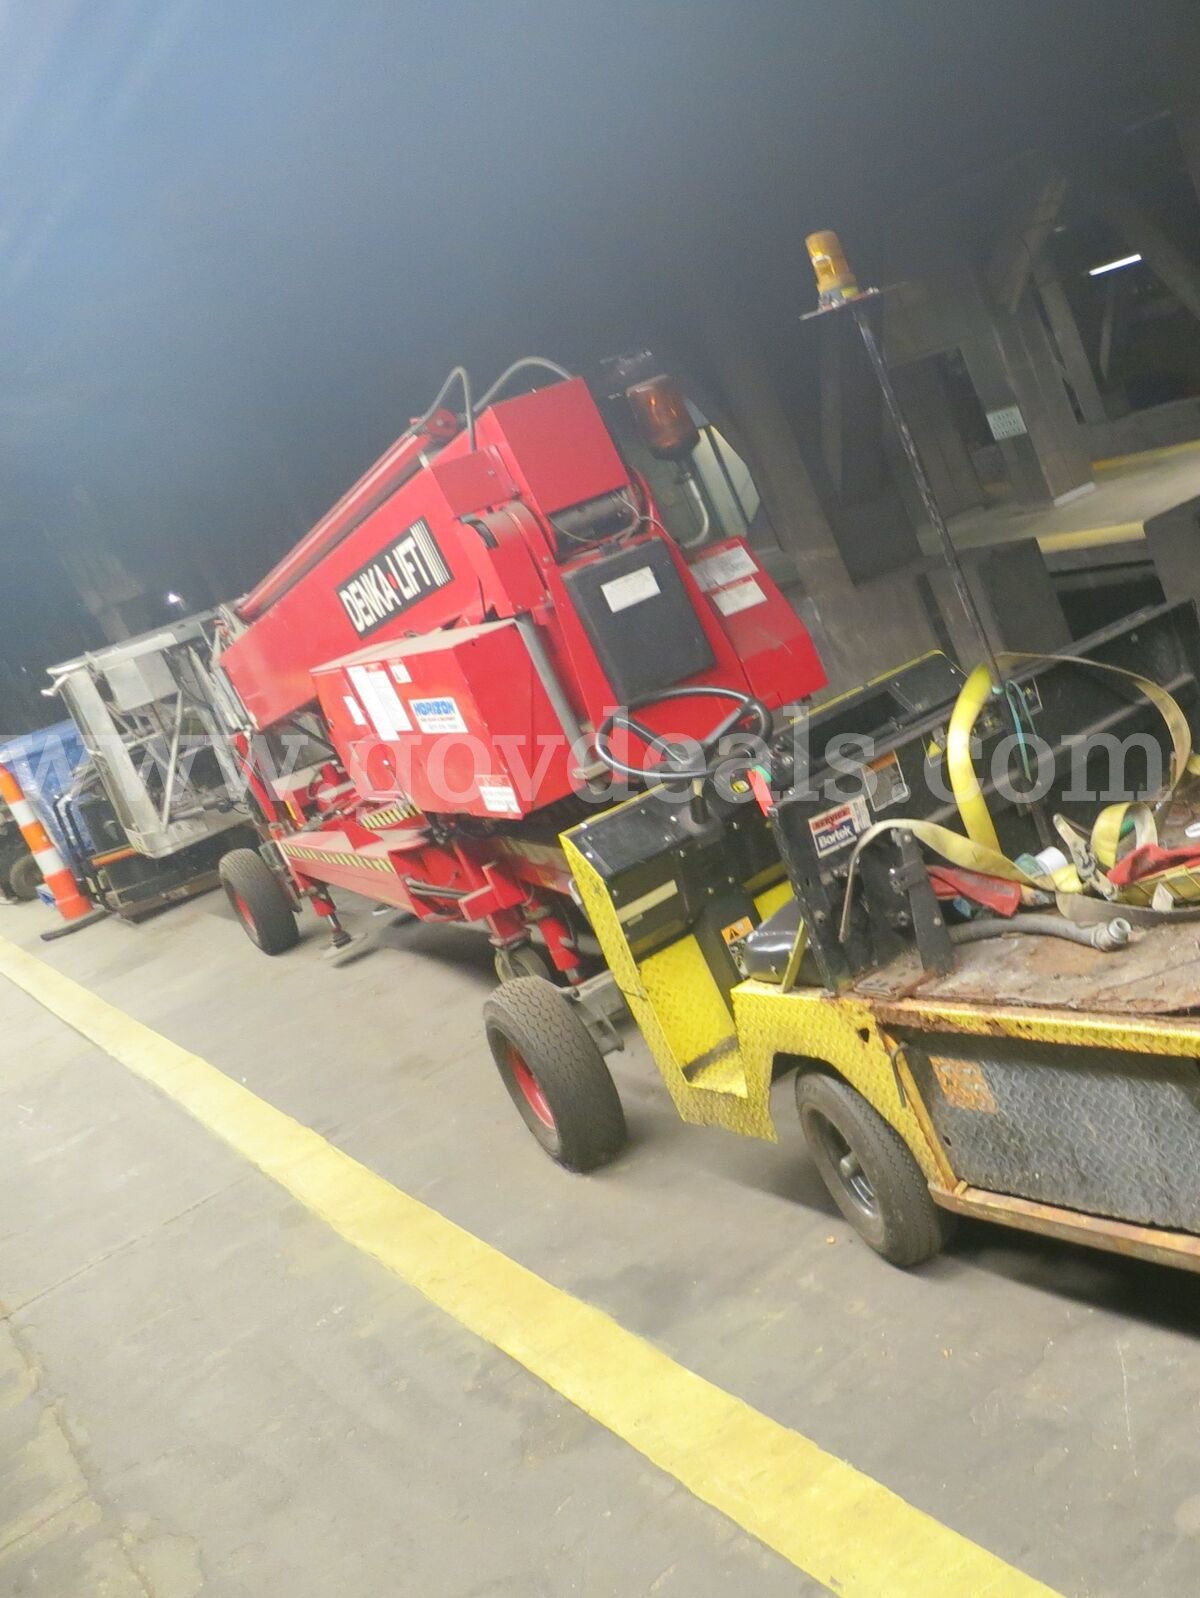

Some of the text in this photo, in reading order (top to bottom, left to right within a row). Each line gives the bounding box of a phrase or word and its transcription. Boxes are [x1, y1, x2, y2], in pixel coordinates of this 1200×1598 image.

[338, 535, 431, 632] DENKA LIFT
[413, 700, 455, 717] HORIZON
[818, 825, 854, 848] Bortek
